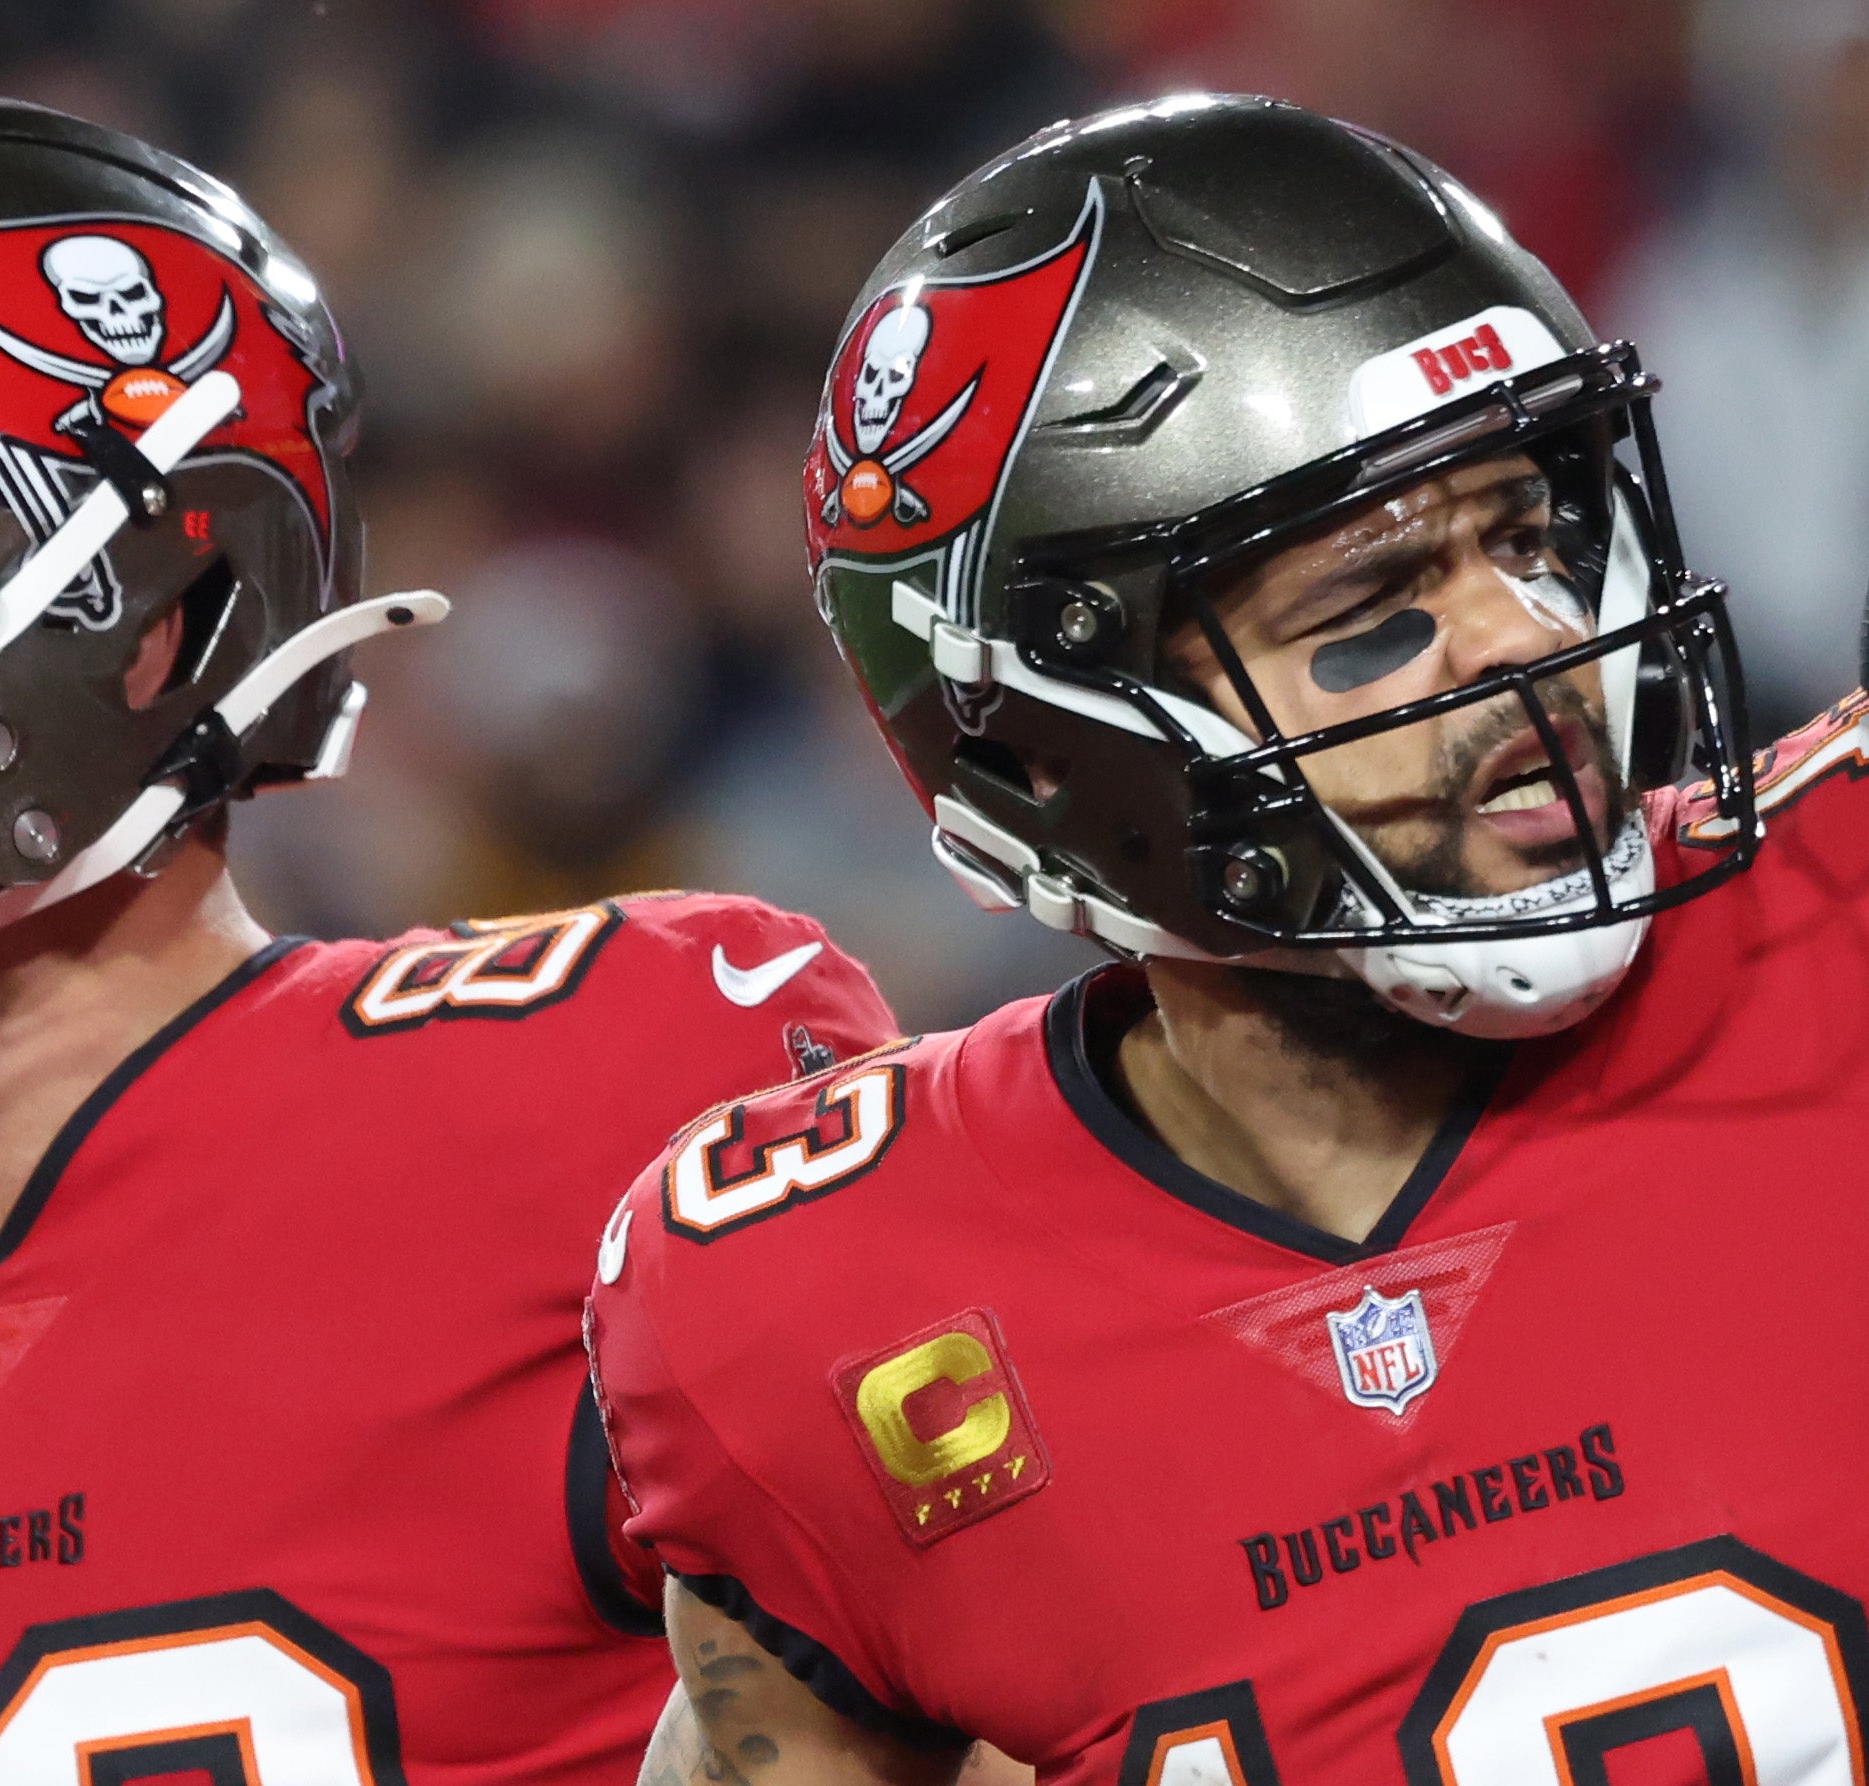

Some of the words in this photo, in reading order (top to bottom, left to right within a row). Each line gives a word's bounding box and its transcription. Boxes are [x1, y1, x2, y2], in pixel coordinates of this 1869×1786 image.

[856, 1331, 1012, 1488] C
[1353, 1341, 1421, 1392] NFL
[1239, 1422, 1627, 1611] BUCCANEERS
